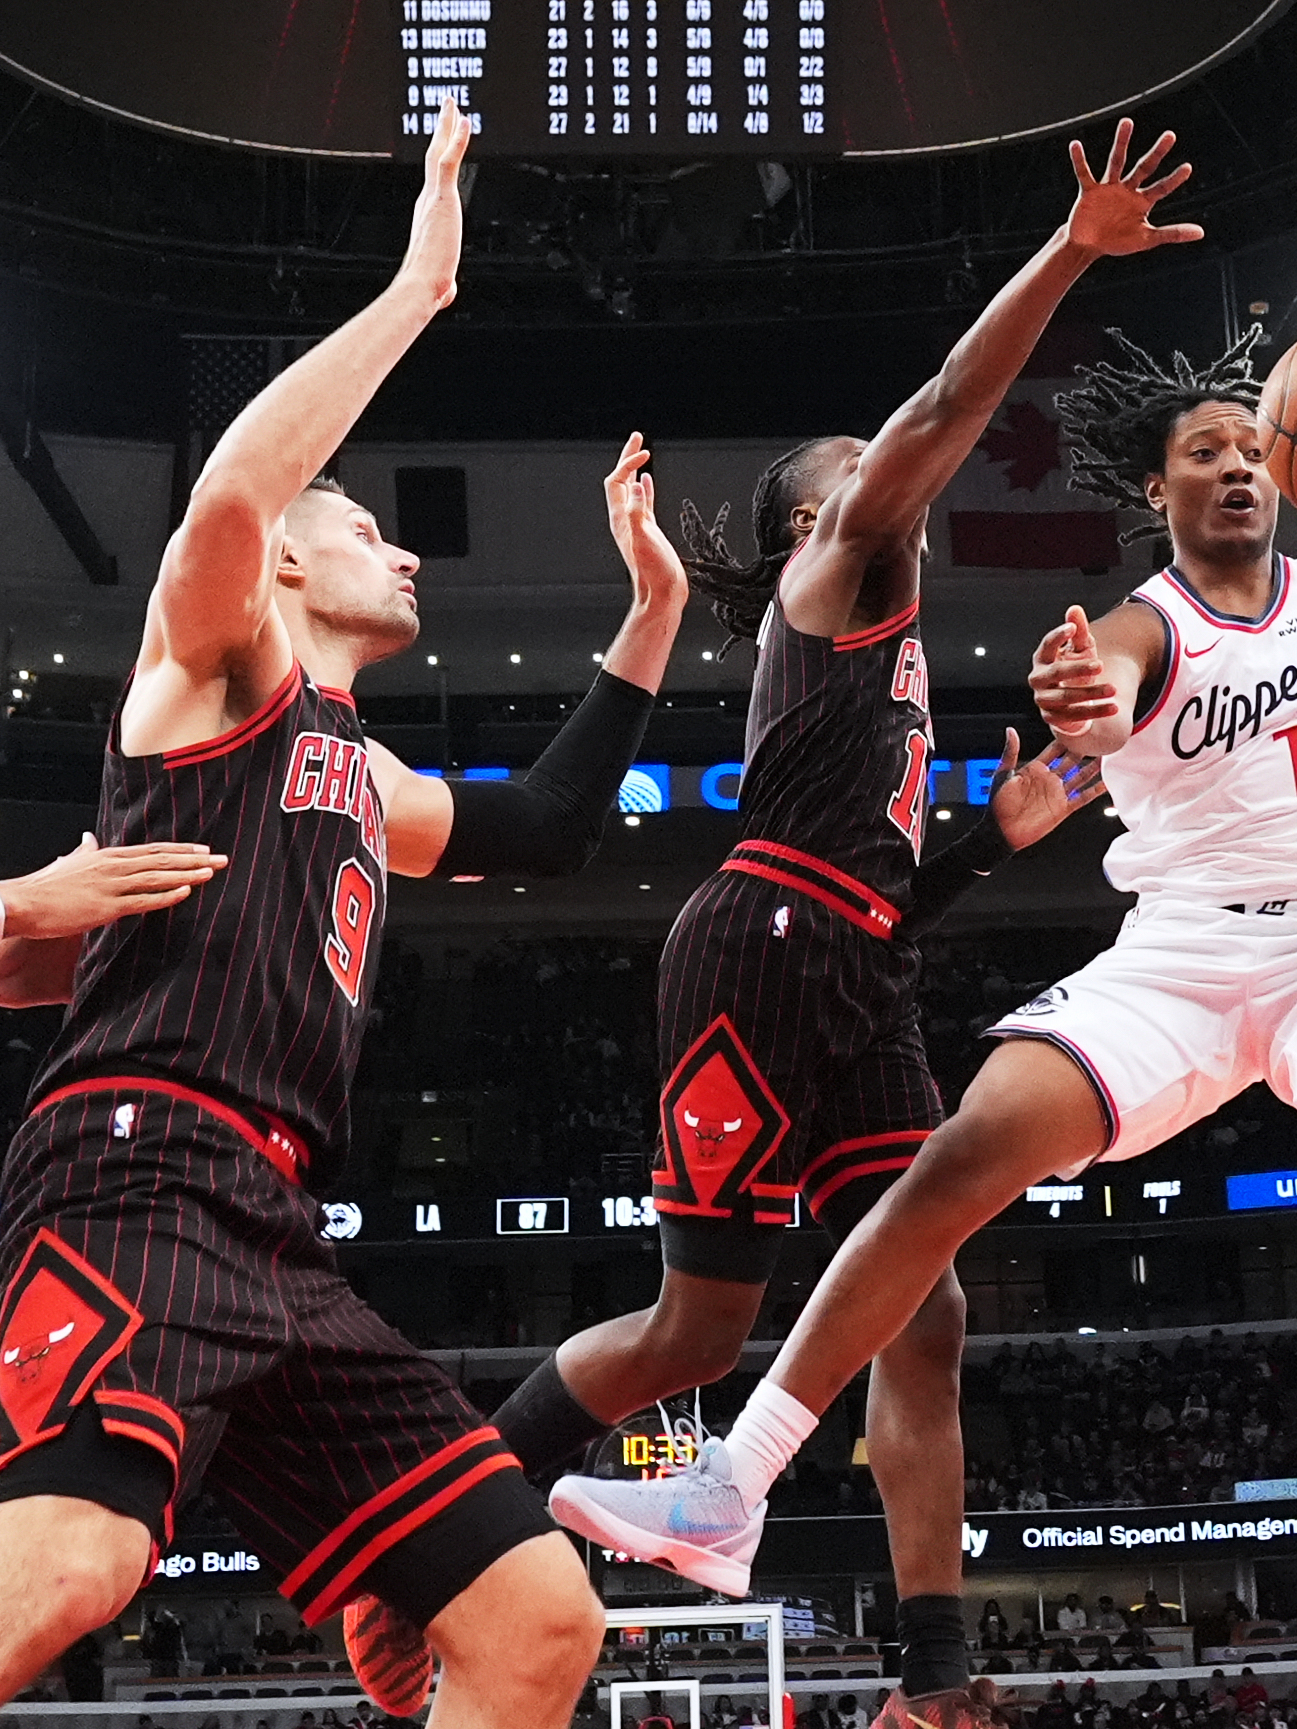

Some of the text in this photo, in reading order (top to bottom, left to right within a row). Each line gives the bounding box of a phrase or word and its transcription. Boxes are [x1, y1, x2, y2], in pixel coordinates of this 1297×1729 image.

[403, 0, 417, 21] 11
[548, 0, 566, 22] 21
[582, 0, 595, 22] 2
[611, 0, 630, 22] 16
[646, 0, 658, 22] 3
[401, 28, 418, 49] 13
[422, 28, 486, 49] HUERTER
[548, 28, 568, 50] 23
[584, 28, 594, 50] 1
[611, 28, 630, 50] 14
[646, 28, 658, 50] 3
[408, 57, 418, 78] 9
[422, 57, 483, 78] VUCEVIC
[548, 56, 567, 78] 27
[584, 56, 594, 78] 1
[611, 56, 631, 78] 12
[743, 56, 767, 78] 0/1
[798, 56, 825, 78] 2/2
[408, 84, 419, 107] 0
[585, 84, 595, 106] 1
[611, 84, 631, 106] 12
[647, 84, 657, 106] 1
[746, 84, 770, 106] 1/4
[799, 84, 825, 106] 3/3
[402, 112, 418, 135] 14
[549, 112, 568, 135] 27
[583, 112, 597, 135] 2
[611, 112, 631, 135] 21
[648, 112, 657, 135] 1
[802, 112, 825, 135] 1/2
[887, 729, 926, 867] 1
[324, 856, 376, 1007] 9
[1026, 1185, 1083, 1203] TIMEOUTS
[1143, 1180, 1181, 1198] FOULS
[415, 1196, 660, 1232] LA 87 10:3
[1048, 1202, 1061, 1218] 4
[1158, 1198, 1167, 1214] 1
[1022, 1525, 1103, 1548] Official
[1109, 1521, 1185, 1549] Spend
[202, 1551, 260, 1573] Bulls
